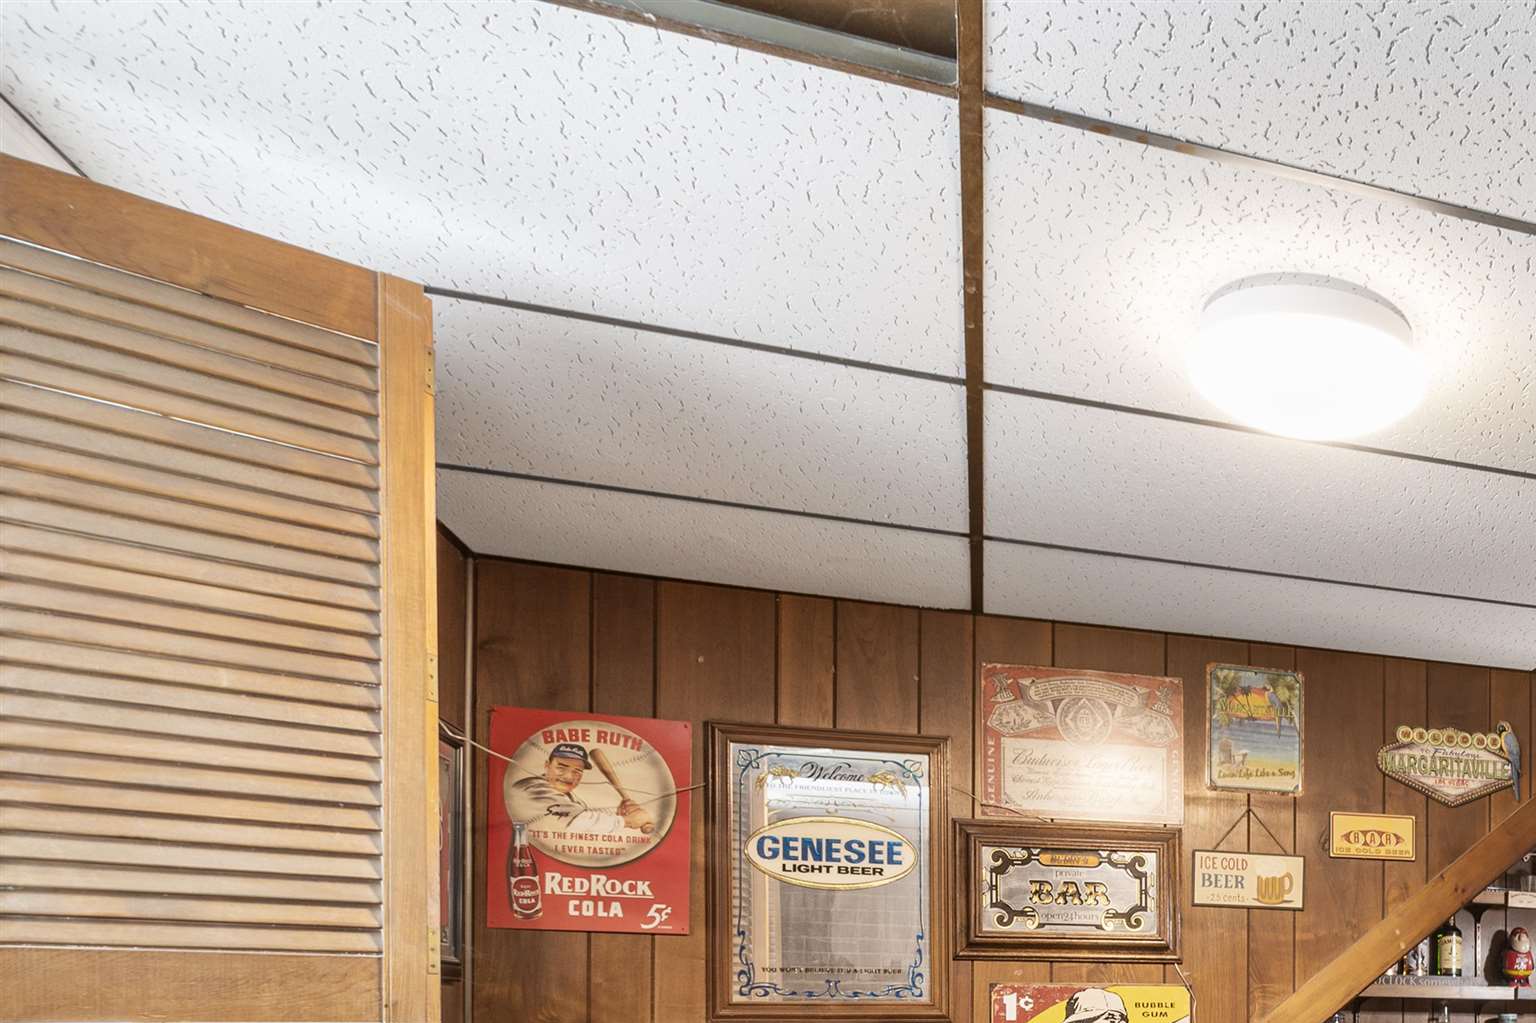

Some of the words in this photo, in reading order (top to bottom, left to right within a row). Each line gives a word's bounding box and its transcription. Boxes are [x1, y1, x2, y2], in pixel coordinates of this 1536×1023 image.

[542, 728, 591, 745] BABE
[596, 730, 643, 751] RUTH
[1401, 730, 1498, 747] WELCOME
[799, 760, 865, 783] Welcome
[986, 736, 996, 805] GENUINE
[1279, 768, 1296, 779] Song
[1382, 752, 1511, 780] MARGARITAVILLE
[552, 831, 567, 840] THE
[569, 832, 599, 842] FINEST
[601, 833, 623, 843] COLA
[625, 835, 652, 845] DRINK
[1352, 831, 1392, 845] BAR
[561, 844, 584, 854] EVER
[756, 835, 904, 866] GENESEE
[1385, 848, 1410, 856] BEER
[782, 863, 833, 874] LIGHT
[837, 866, 885, 877] BEER
[1200, 855, 1218, 870] ICE
[1220, 857, 1249, 871] COLD
[1201, 872, 1245, 889] BEER
[1029, 880, 1110, 905] BAR
[568, 899, 624, 918] COLA
[640, 903, 673, 929] 5¢
[1003, 992, 1035, 1021] 1¢
[1134, 1001, 1176, 1009] BUBBLE
